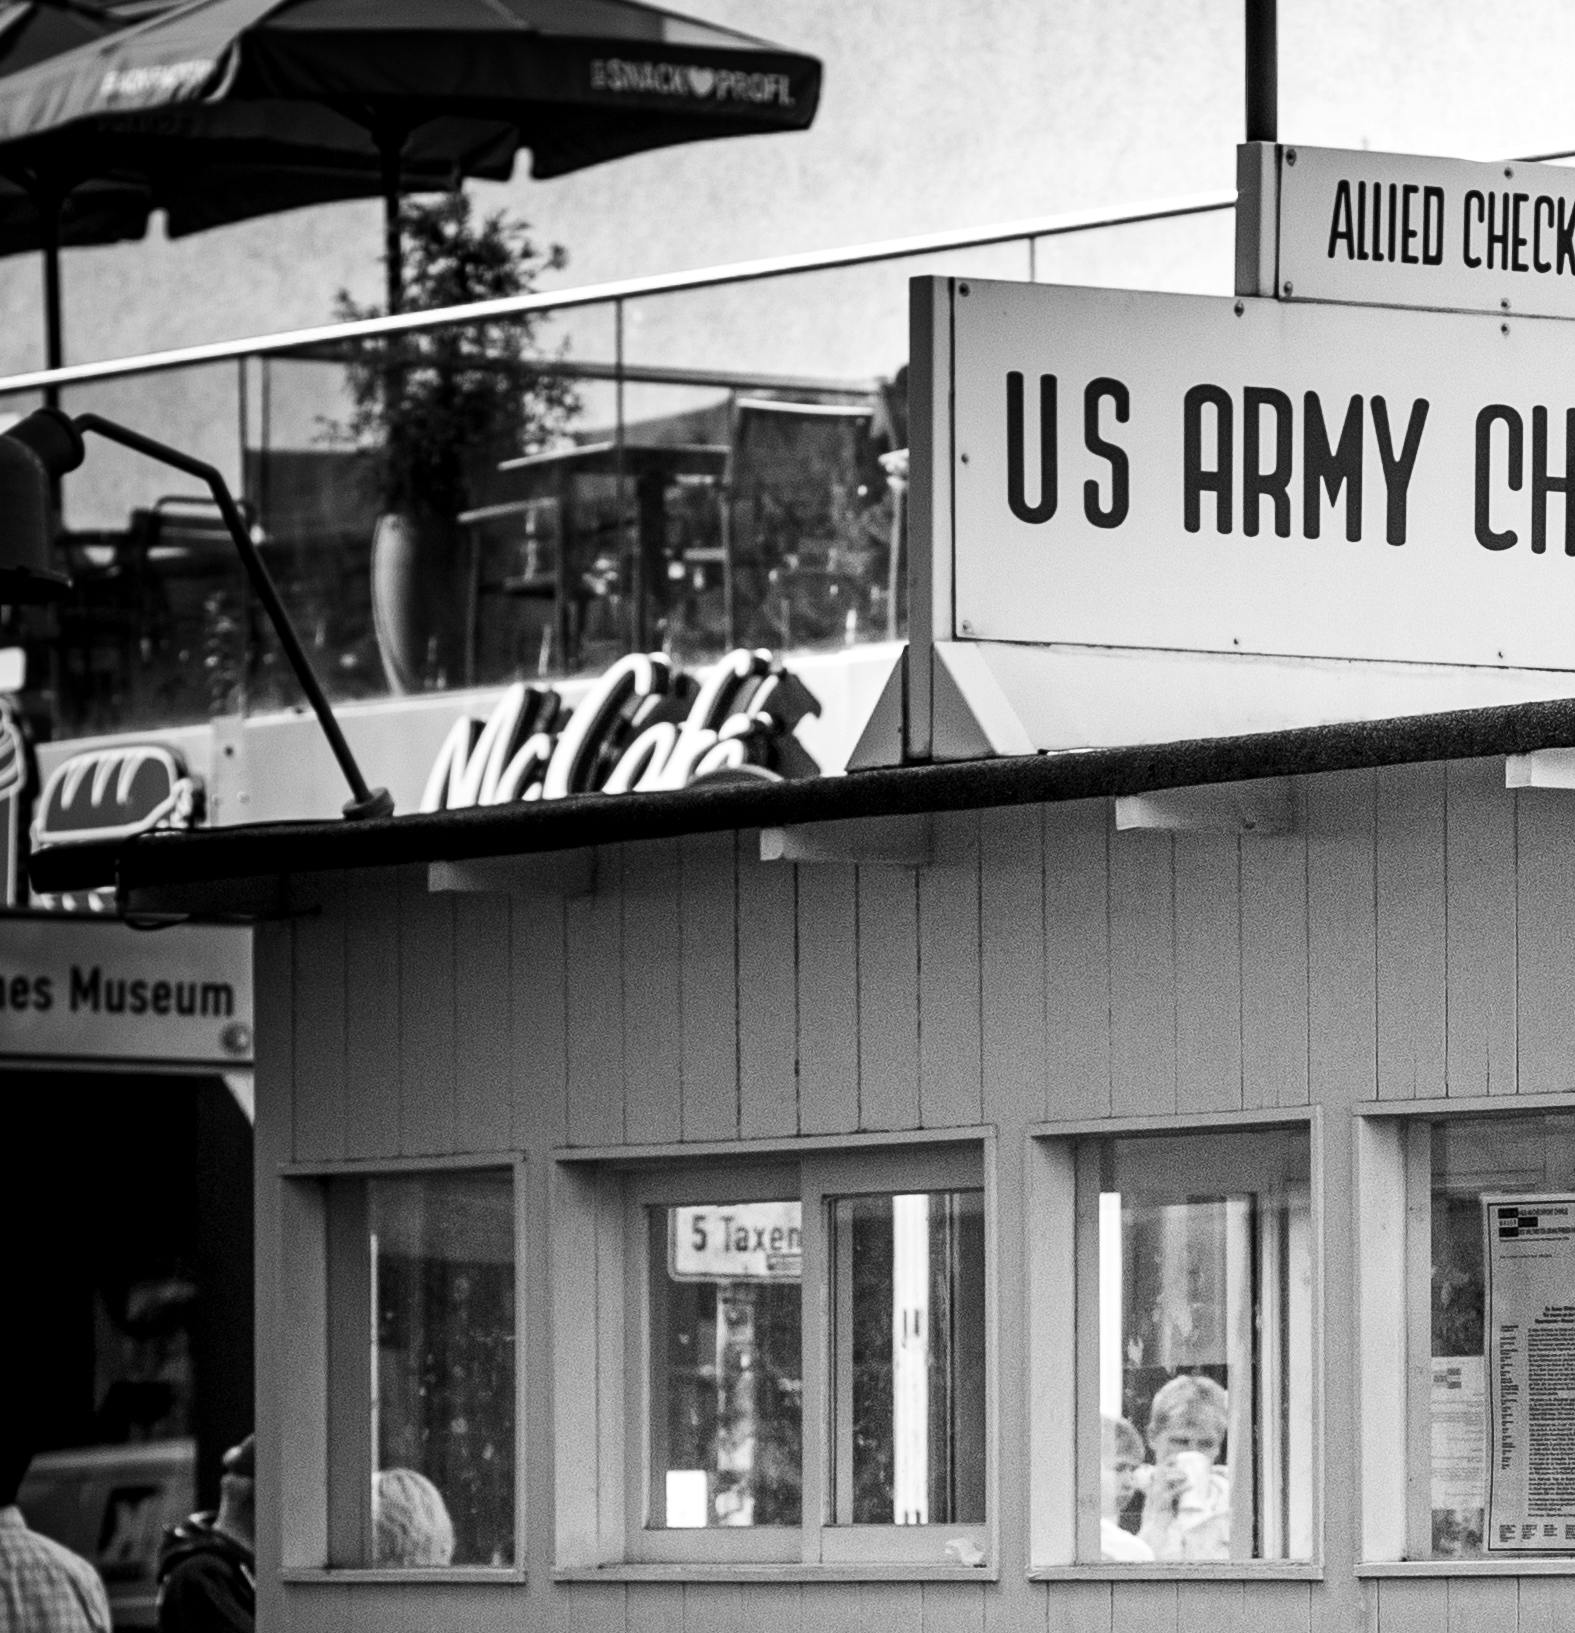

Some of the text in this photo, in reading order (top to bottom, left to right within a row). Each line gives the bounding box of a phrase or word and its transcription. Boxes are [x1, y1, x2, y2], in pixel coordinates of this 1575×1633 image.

[1327, 179, 1445, 267] ALLIED
[1183, 381, 1431, 546] ARMY
[70, 965, 235, 1017] Museum
[692, 1214, 801, 1252] 5 Taxen
